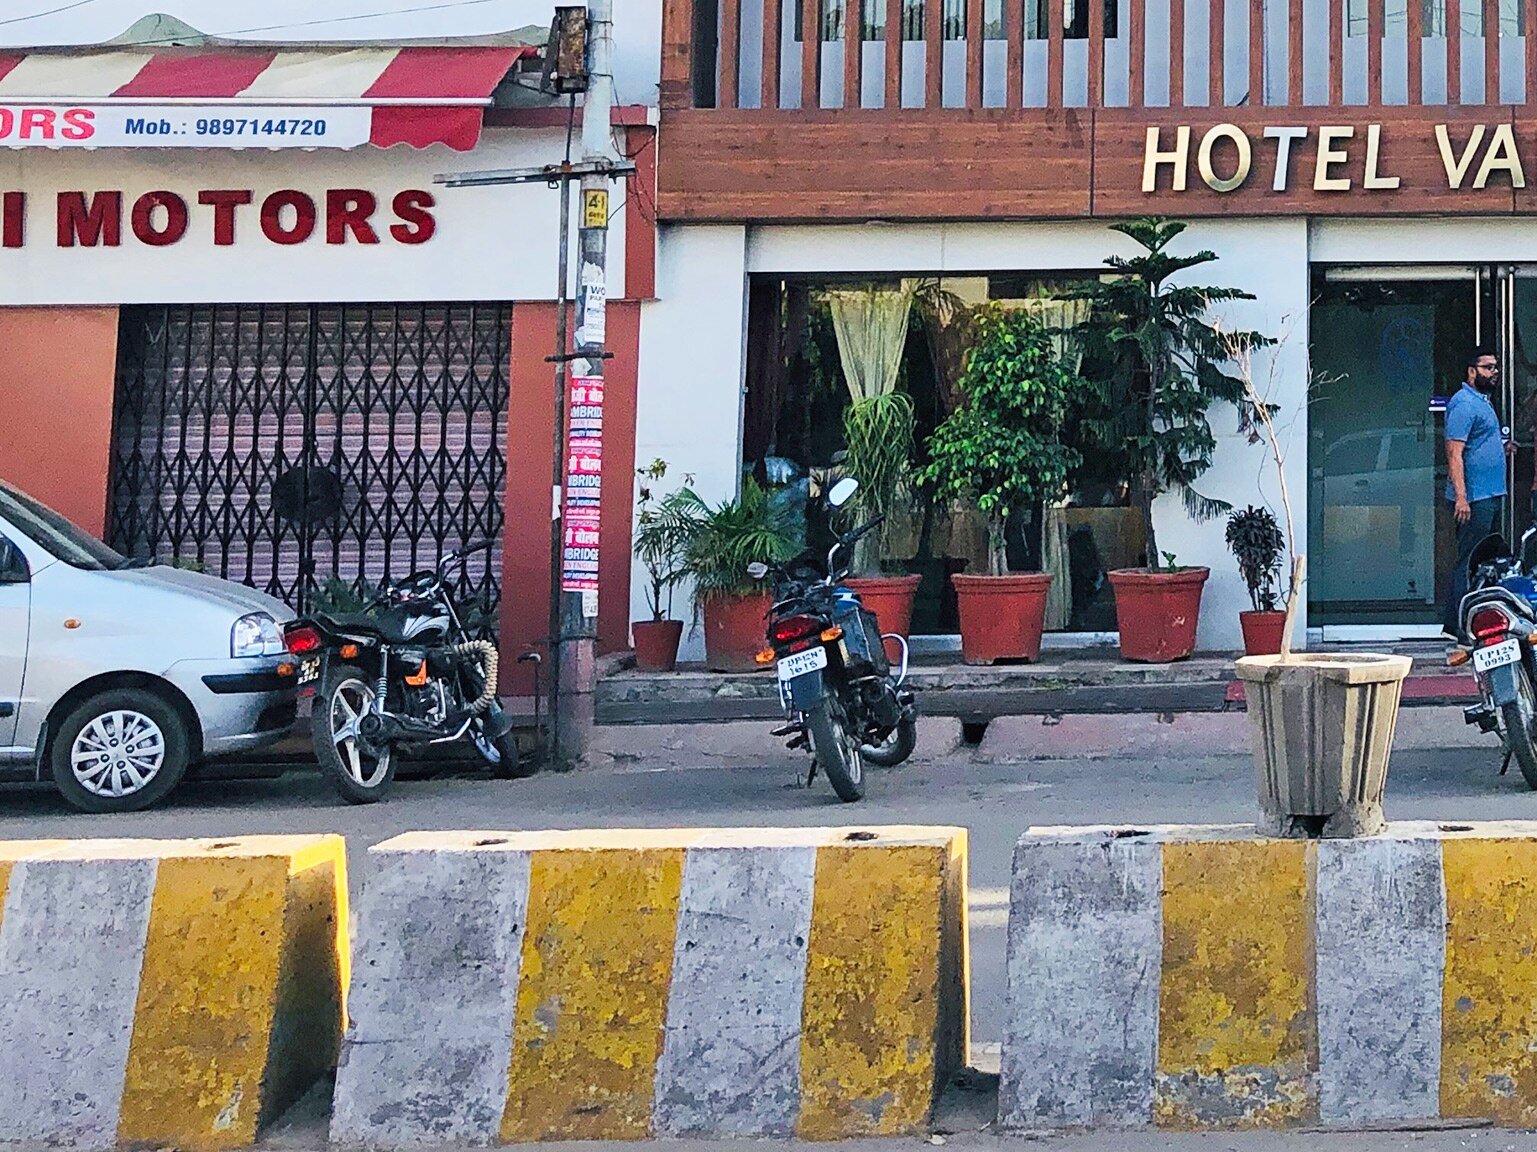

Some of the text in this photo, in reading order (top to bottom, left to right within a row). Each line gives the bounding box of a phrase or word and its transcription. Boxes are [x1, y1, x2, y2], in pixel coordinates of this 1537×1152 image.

[125, 118, 326, 136] Mob.: 9897144720
[1142, 124, 1401, 193] HOTEL
[56, 190, 438, 247] MOTORS
